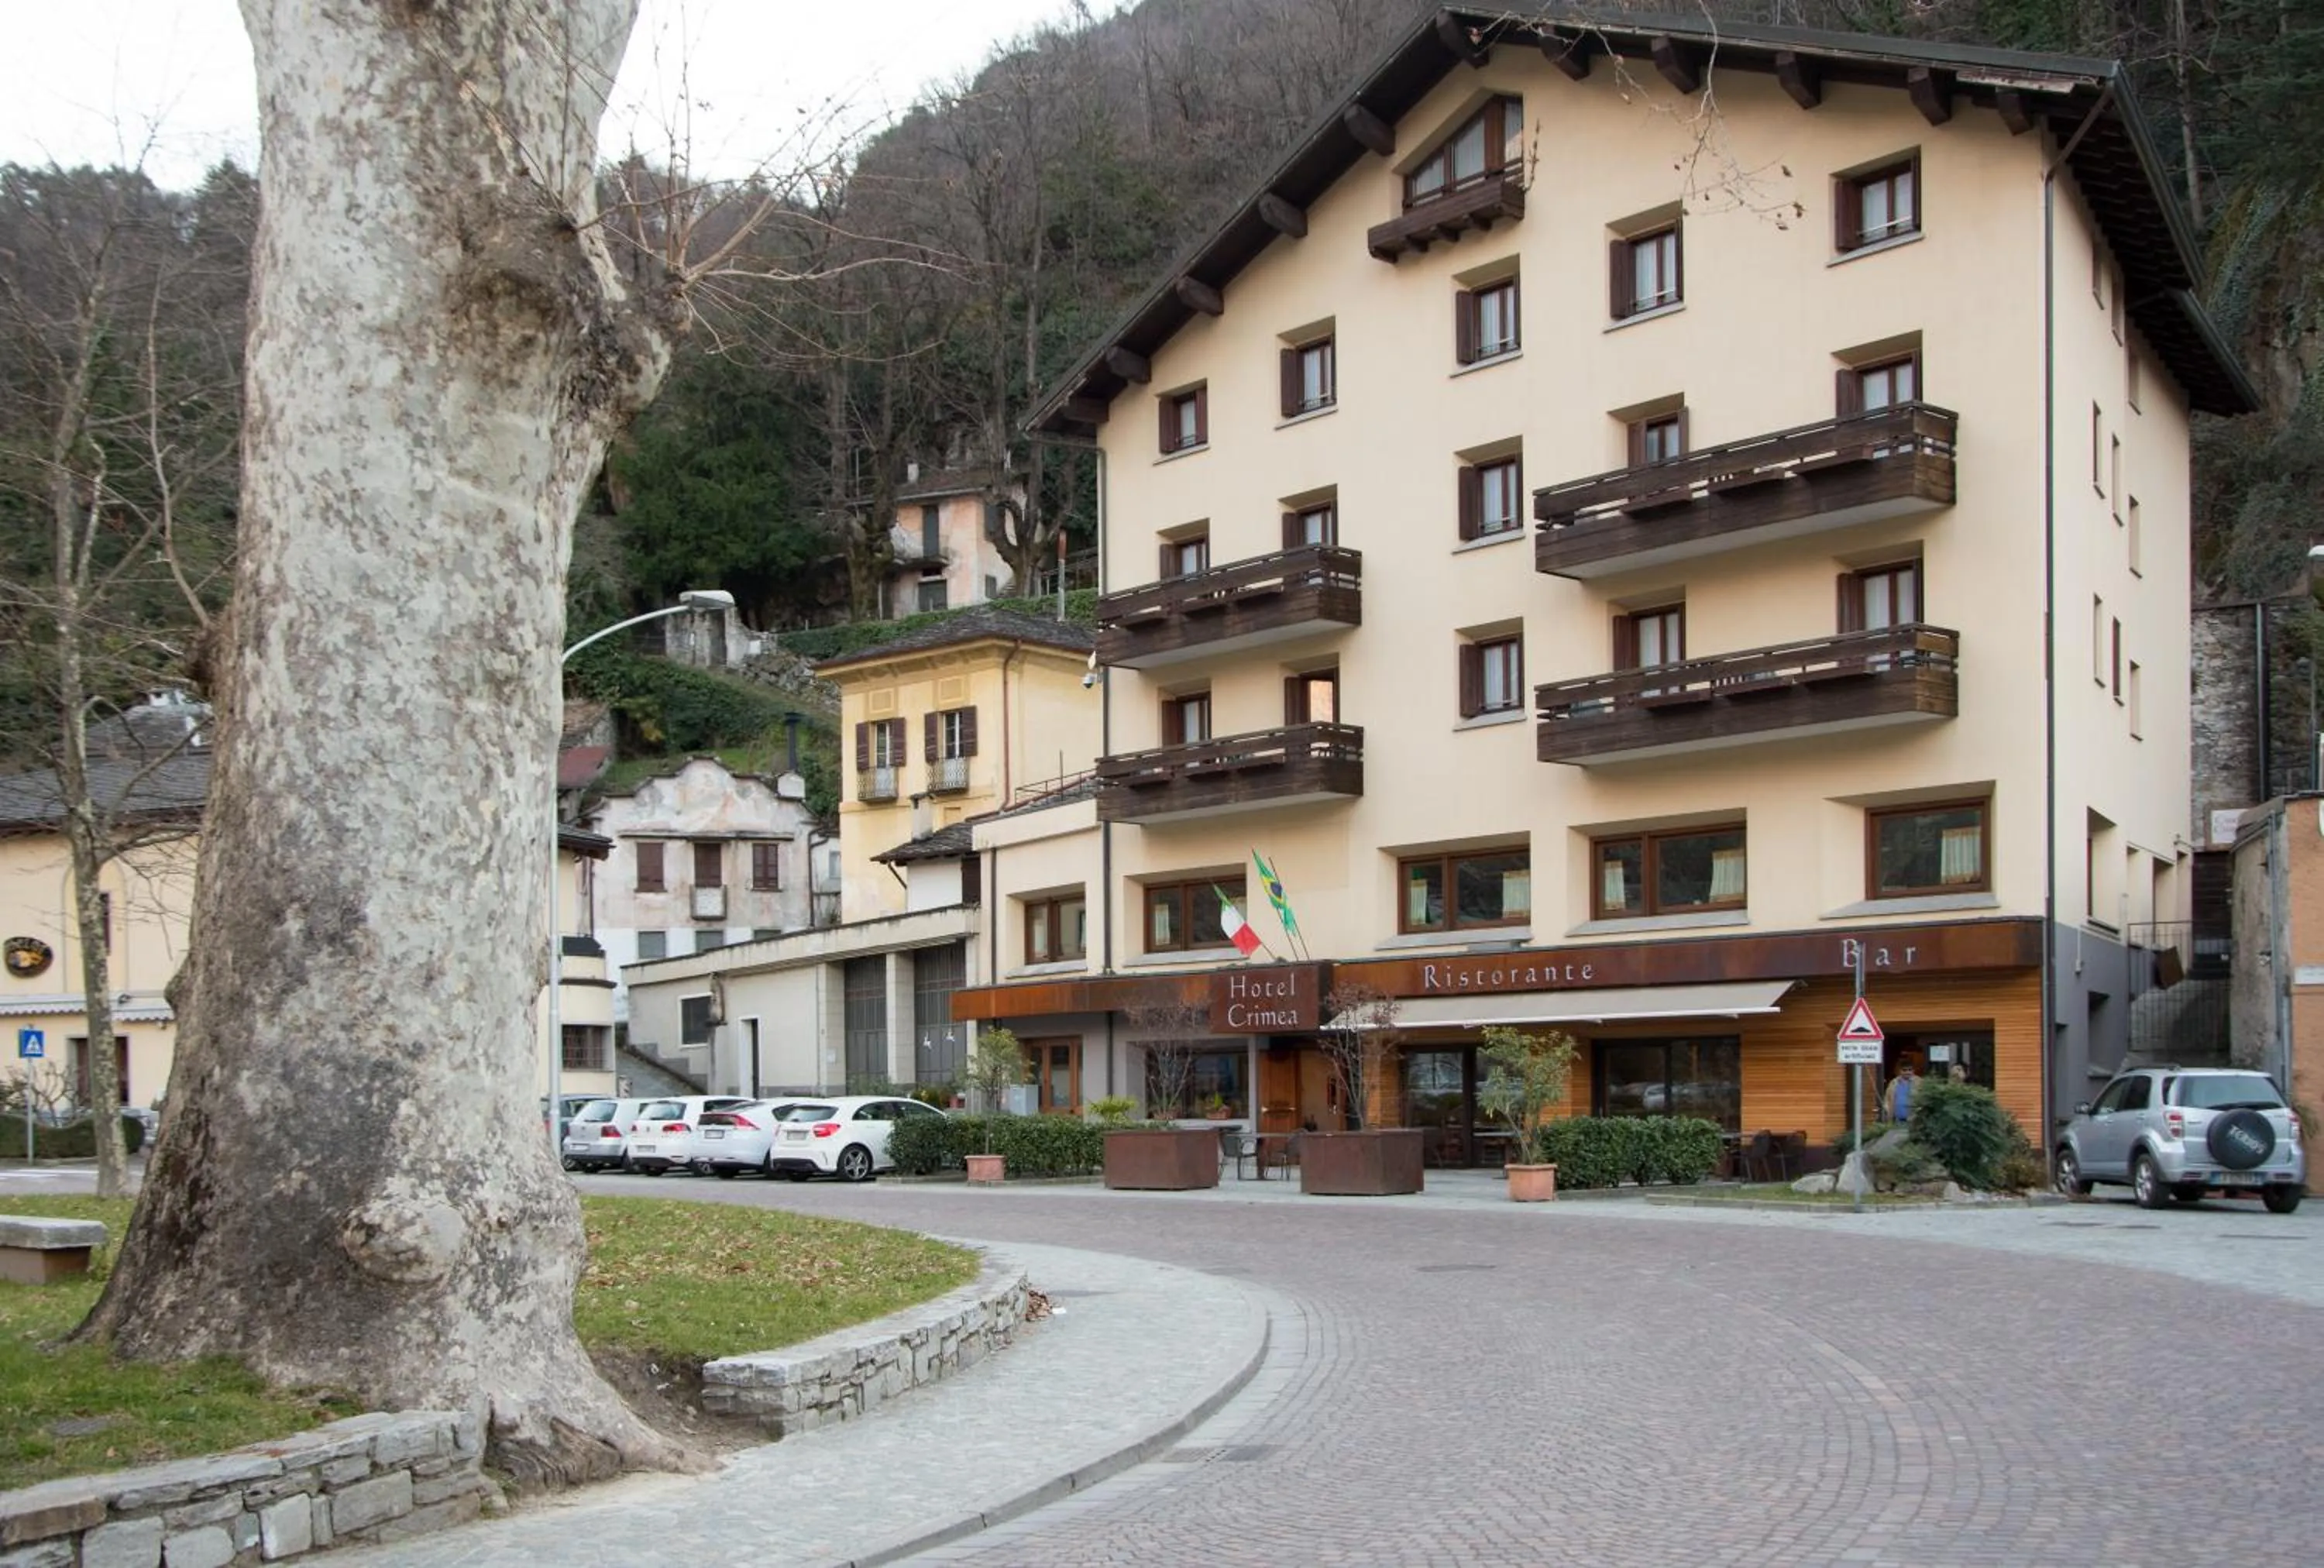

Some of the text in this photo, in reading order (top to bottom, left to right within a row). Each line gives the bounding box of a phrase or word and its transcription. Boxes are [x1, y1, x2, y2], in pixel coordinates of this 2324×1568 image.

[1842, 938, 1916, 968] Bar
[1229, 972, 1296, 999] Hotel
[1424, 964, 1595, 988] Ristorante
[1227, 1003, 1299, 1027] Crimea
